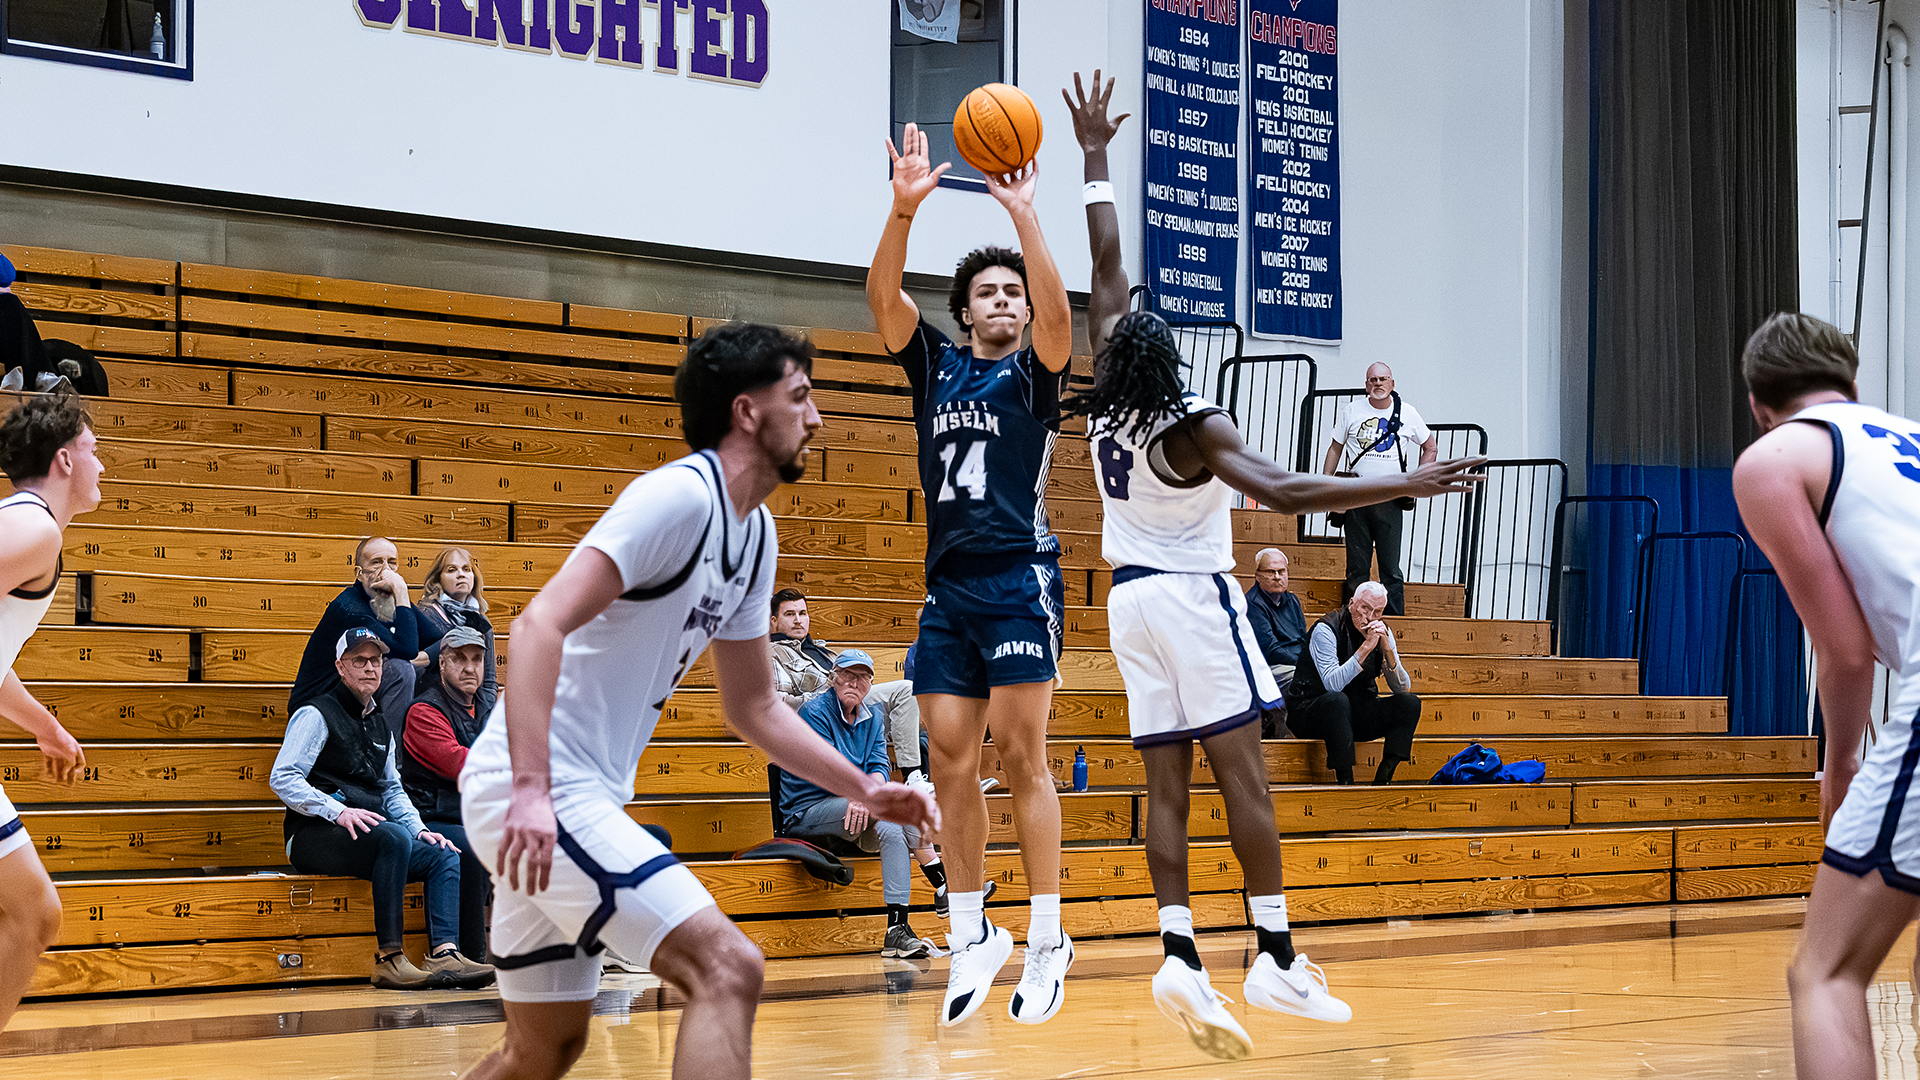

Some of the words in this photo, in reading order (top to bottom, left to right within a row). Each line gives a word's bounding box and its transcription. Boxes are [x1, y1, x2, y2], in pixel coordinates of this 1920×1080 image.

[1180, 27, 1209, 47] 1994
[1251, 10, 1336, 55] CHAMPIONS
[1148, 46, 1176, 67] WOMEN'S
[1178, 53, 1200, 72] TENNIS
[1278, 49, 1309, 69] 2000
[1256, 63, 1288, 82] FIELD
[1289, 69, 1333, 90] HOCKEY
[1180, 84, 1186, 96] &
[1187, 82, 1204, 101] KATE
[1282, 85, 1310, 105] 2001
[1178, 107, 1208, 127] 1997
[1255, 98, 1281, 118] MEN'S
[1283, 103, 1334, 126] BASKETBALL
[1257, 118, 1288, 136] FIELD
[1290, 123, 1332, 144] HOCKEY
[1262, 137, 1295, 156] WOMEN'S
[1299, 143, 1328, 162] TENNIS
[1178, 161, 1208, 182] 1998
[1282, 159, 1311, 178] 2002
[1256, 174, 1288, 193] FIELD
[1290, 179, 1331, 199] HOCKEY
[1176, 188, 1199, 207] TENNIS
[1281, 197, 1310, 215] 2004
[1254, 211, 1282, 230] MEN'S
[1283, 216, 1297, 232] ICE
[1299, 218, 1332, 236] HOCKEY
[1178, 243, 1206, 262] 1999
[1280, 234, 1310, 252] 2007
[1261, 250, 1296, 269] WOMEN'S
[1299, 255, 1328, 272] TENNIS
[1159, 267, 1180, 285] MEN'S
[1182, 271, 1223, 291] BASKETBALL
[1281, 271, 1310, 289] 2008
[1190, 299, 1226, 318] LACROSSE
[1257, 288, 1282, 305] MEN'S
[1283, 290, 1298, 306] ICE
[1301, 292, 1333, 309] HOCKEY
[936, 400, 988, 413] SAINT
[933, 409, 1001, 439] ANSELM
[1862, 423, 1920, 483] 3
[207, 461, 218, 472] 35
[268, 464, 279, 475] 36
[382, 471, 393, 482] 38
[937, 440, 988, 502] 14
[1098, 436, 1134, 501] 8
[117, 499, 129, 510] 32
[182, 502, 193, 513] 33
[307, 508, 318, 519] 35
[480, 517, 491, 528] 38
[538, 519, 548, 529] 39
[85, 543, 99, 555] 30
[154, 546, 166, 558] 31
[220, 549, 232, 560] 32
[285, 551, 296, 563] 33
[407, 557, 418, 567] 35
[523, 561, 533, 571] 37
[122, 592, 136, 603] 29
[193, 596, 207, 608] 30
[261, 599, 272, 611] 31
[511, 606, 521, 616] 35
[79, 649, 92, 661] 27
[148, 649, 162, 661] 28
[232, 649, 246, 661] 29
[992, 641, 1043, 660] HAWKS
[120, 706, 134, 718] 26
[193, 706, 205, 718] 27
[262, 706, 275, 718] 28
[4, 767, 19, 780] 23
[84, 767, 98, 780] 24
[163, 767, 177, 780] 25
[239, 767, 253, 779] 26
[658, 762, 670, 774] 32
[718, 762, 730, 774] 33
[46, 836, 62, 849] 22
[129, 833, 144, 847] 23
[206, 832, 222, 845] 24
[90, 907, 104, 920] 21
[175, 903, 190, 917] 22
[258, 901, 272, 914] 23
[759, 881, 772, 893] 30
